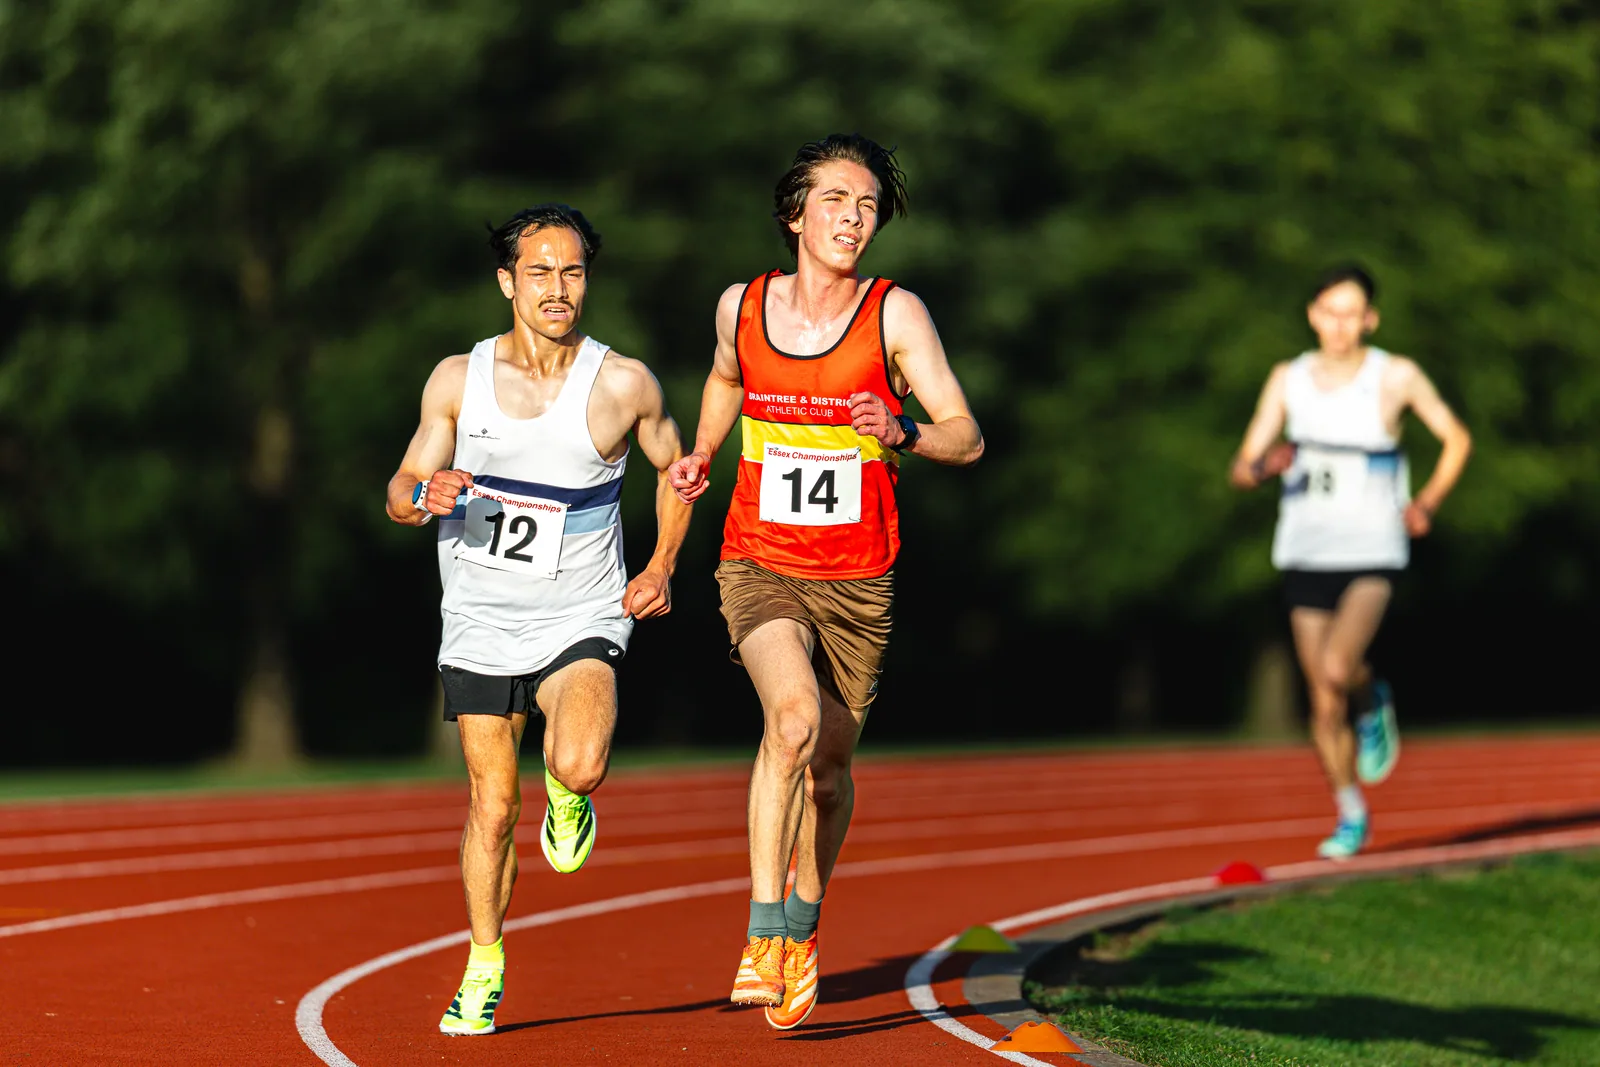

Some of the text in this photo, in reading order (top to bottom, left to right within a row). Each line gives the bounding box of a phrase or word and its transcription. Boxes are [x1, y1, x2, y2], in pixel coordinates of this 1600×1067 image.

[748, 392, 852, 407] BRAINTREE & DISTRIC
[766, 405, 834, 417] ATHLETIC CLUB
[768, 447, 857, 463] Essex Championships
[472, 488, 562, 513] Essex Championships
[782, 467, 839, 514] 14
[485, 511, 538, 563] 12
